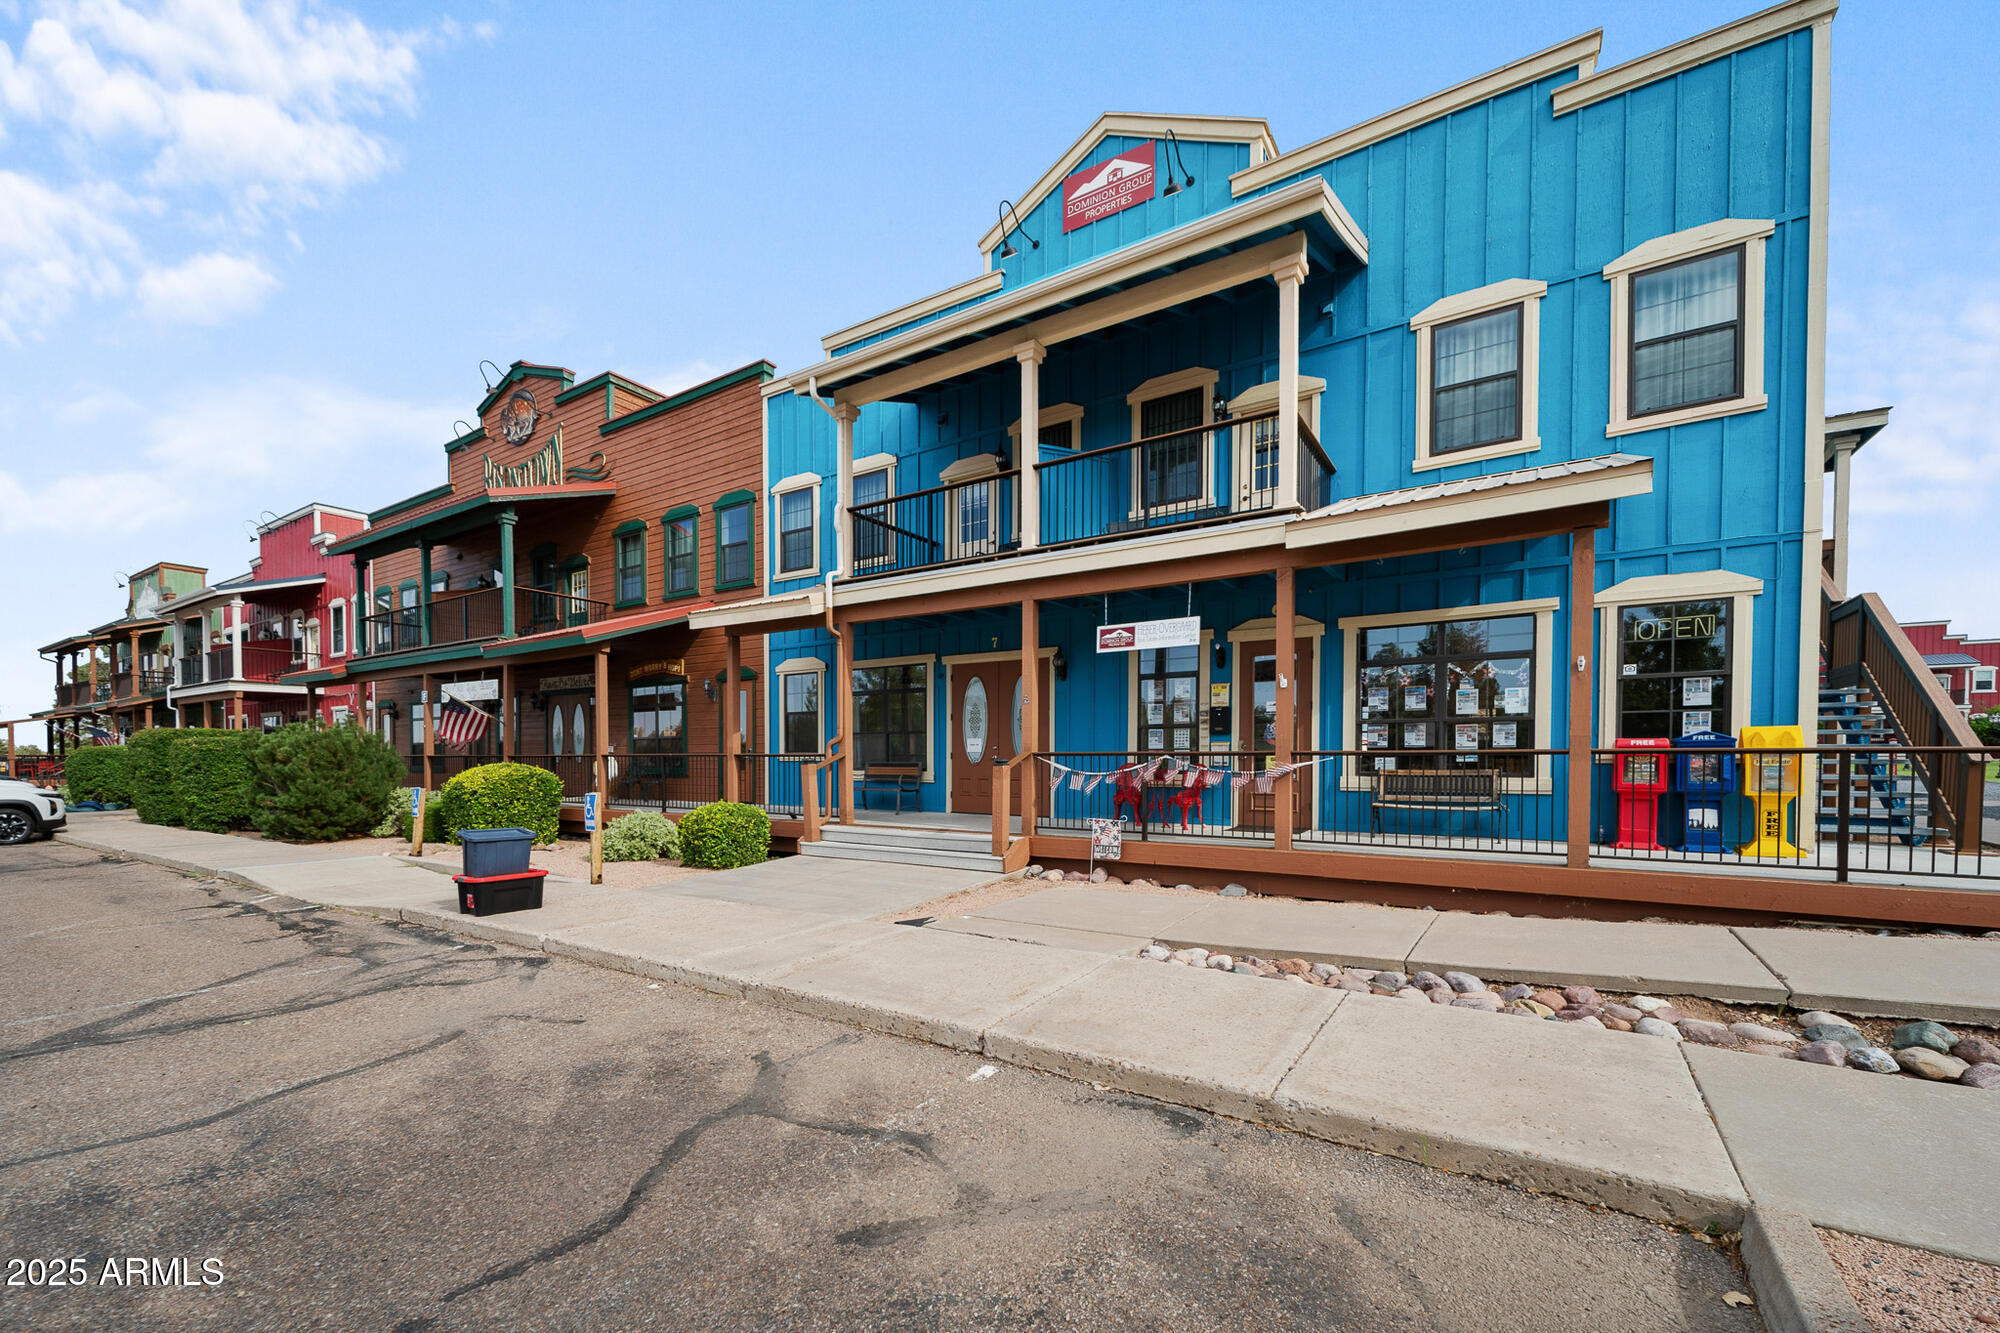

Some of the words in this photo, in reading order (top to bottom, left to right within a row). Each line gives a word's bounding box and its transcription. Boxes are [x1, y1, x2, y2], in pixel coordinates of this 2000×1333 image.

[1067, 187, 1116, 214] DOMINION
[1118, 172, 1153, 193] GROUP
[1084, 194, 1133, 220] PROPERTIES
[1638, 616, 1712, 641] OPEN
[991, 636, 999, 649] 7
